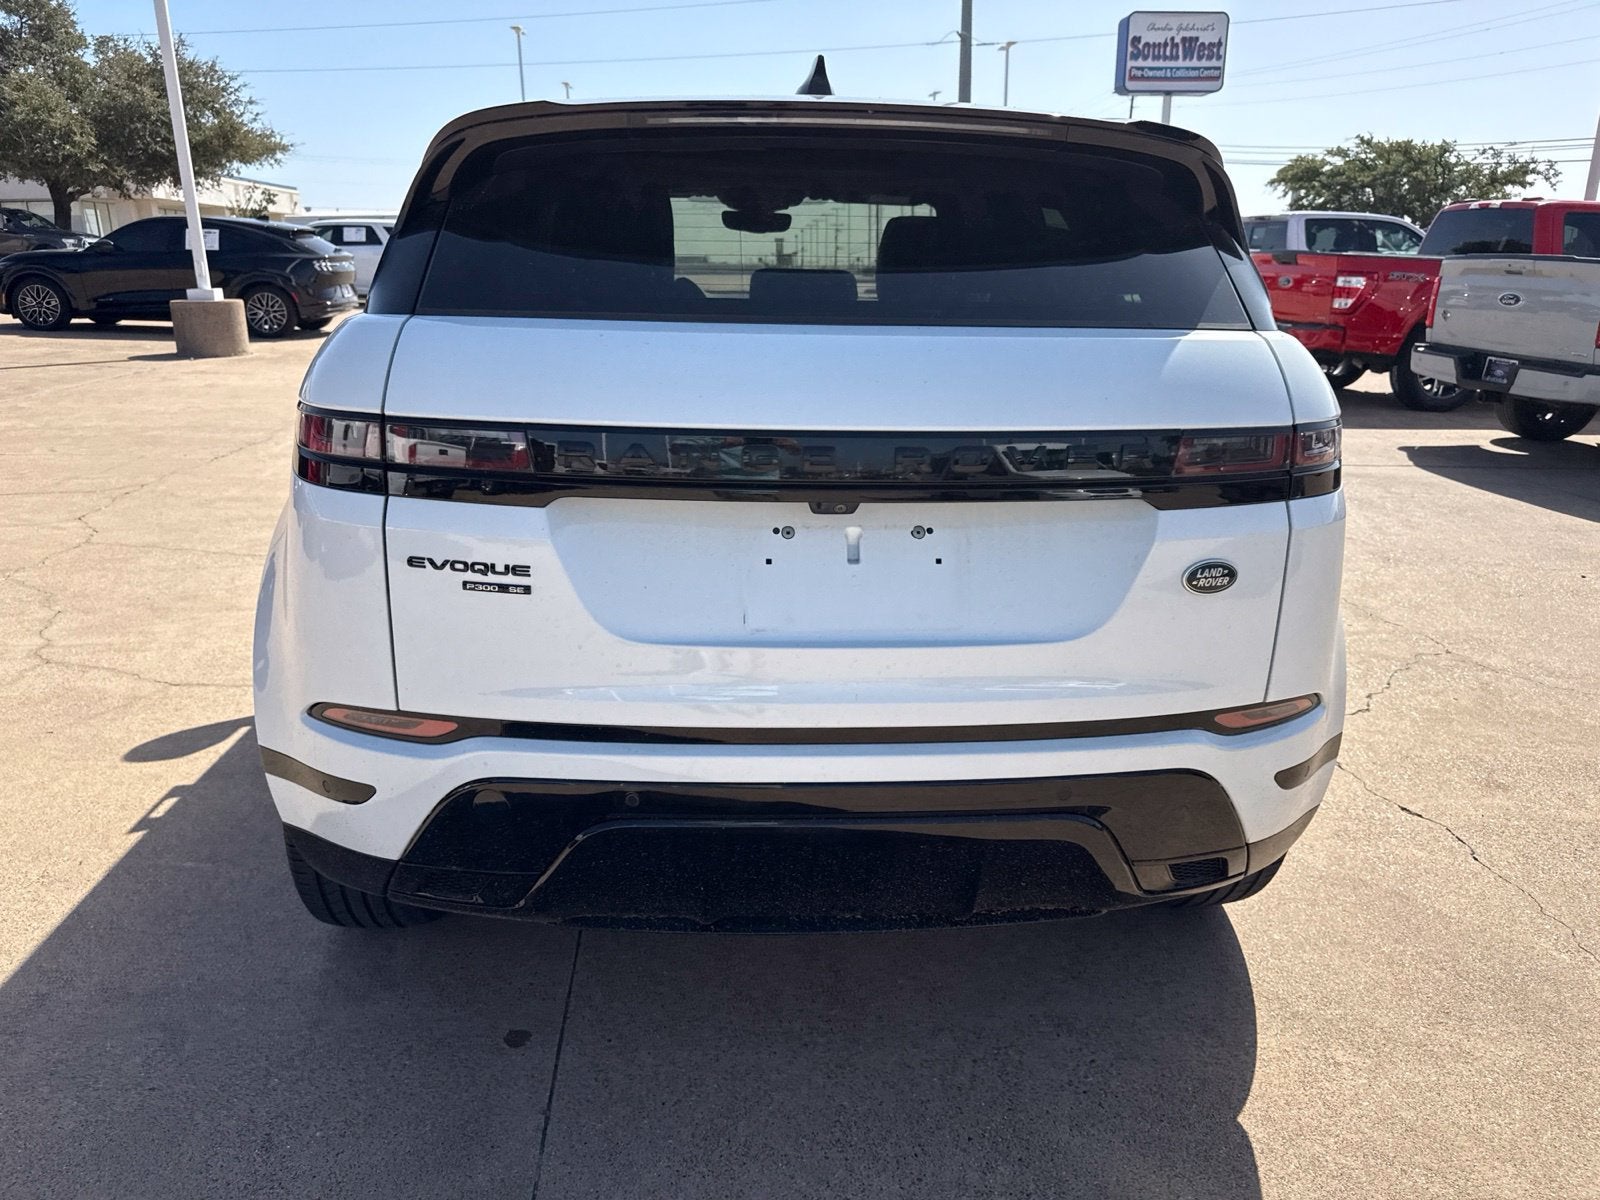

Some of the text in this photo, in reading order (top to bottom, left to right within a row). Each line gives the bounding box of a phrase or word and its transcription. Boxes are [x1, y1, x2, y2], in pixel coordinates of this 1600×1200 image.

[1130, 36, 1222, 62] SouthWest
[1132, 69, 1221, 77] Pre-Owned & Collision Center
[407, 555, 531, 577] EVOQUE
[1197, 568, 1223, 577] LAND
[1198, 577, 1229, 586] ROVER
[466, 583, 498, 592] P300
